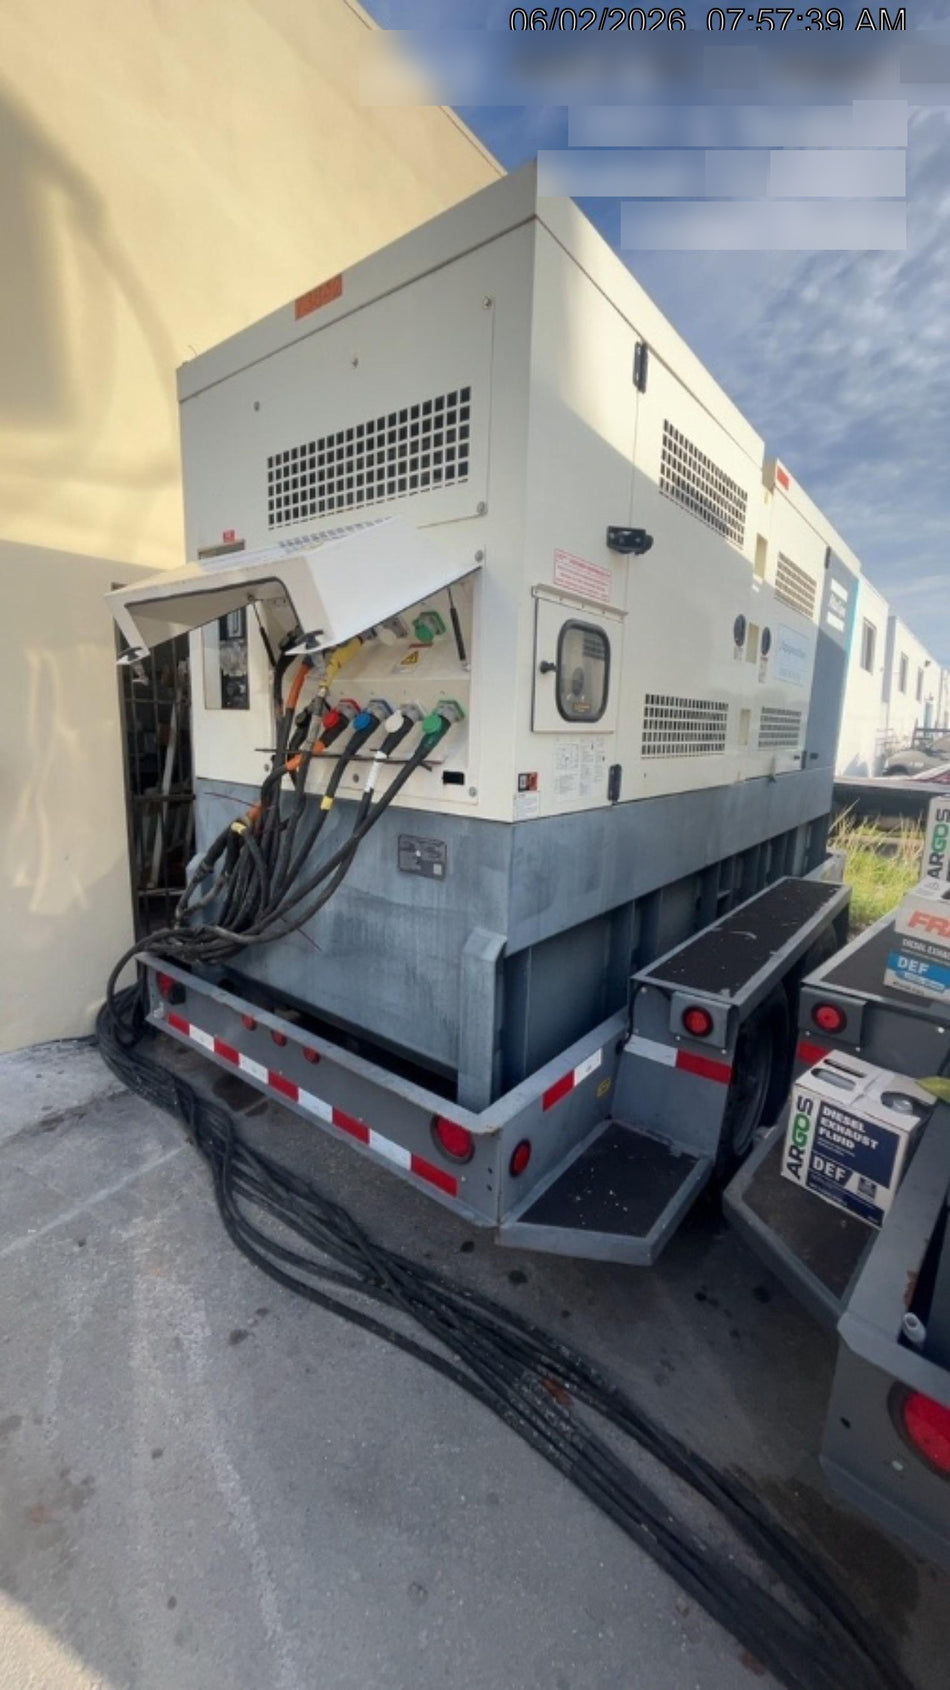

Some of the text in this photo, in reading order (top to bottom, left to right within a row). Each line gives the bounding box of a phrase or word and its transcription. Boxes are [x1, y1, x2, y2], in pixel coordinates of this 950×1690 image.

[927, 808, 950, 880] ARGOS
[897, 955, 930, 975] DEF
[823, 1105, 866, 1133] DIESEL
[786, 1095, 813, 1180] ARGOS
[818, 1127, 855, 1149] FLUID
[820, 1117, 879, 1150] EXHAUST
[812, 1155, 846, 1181] DEF
